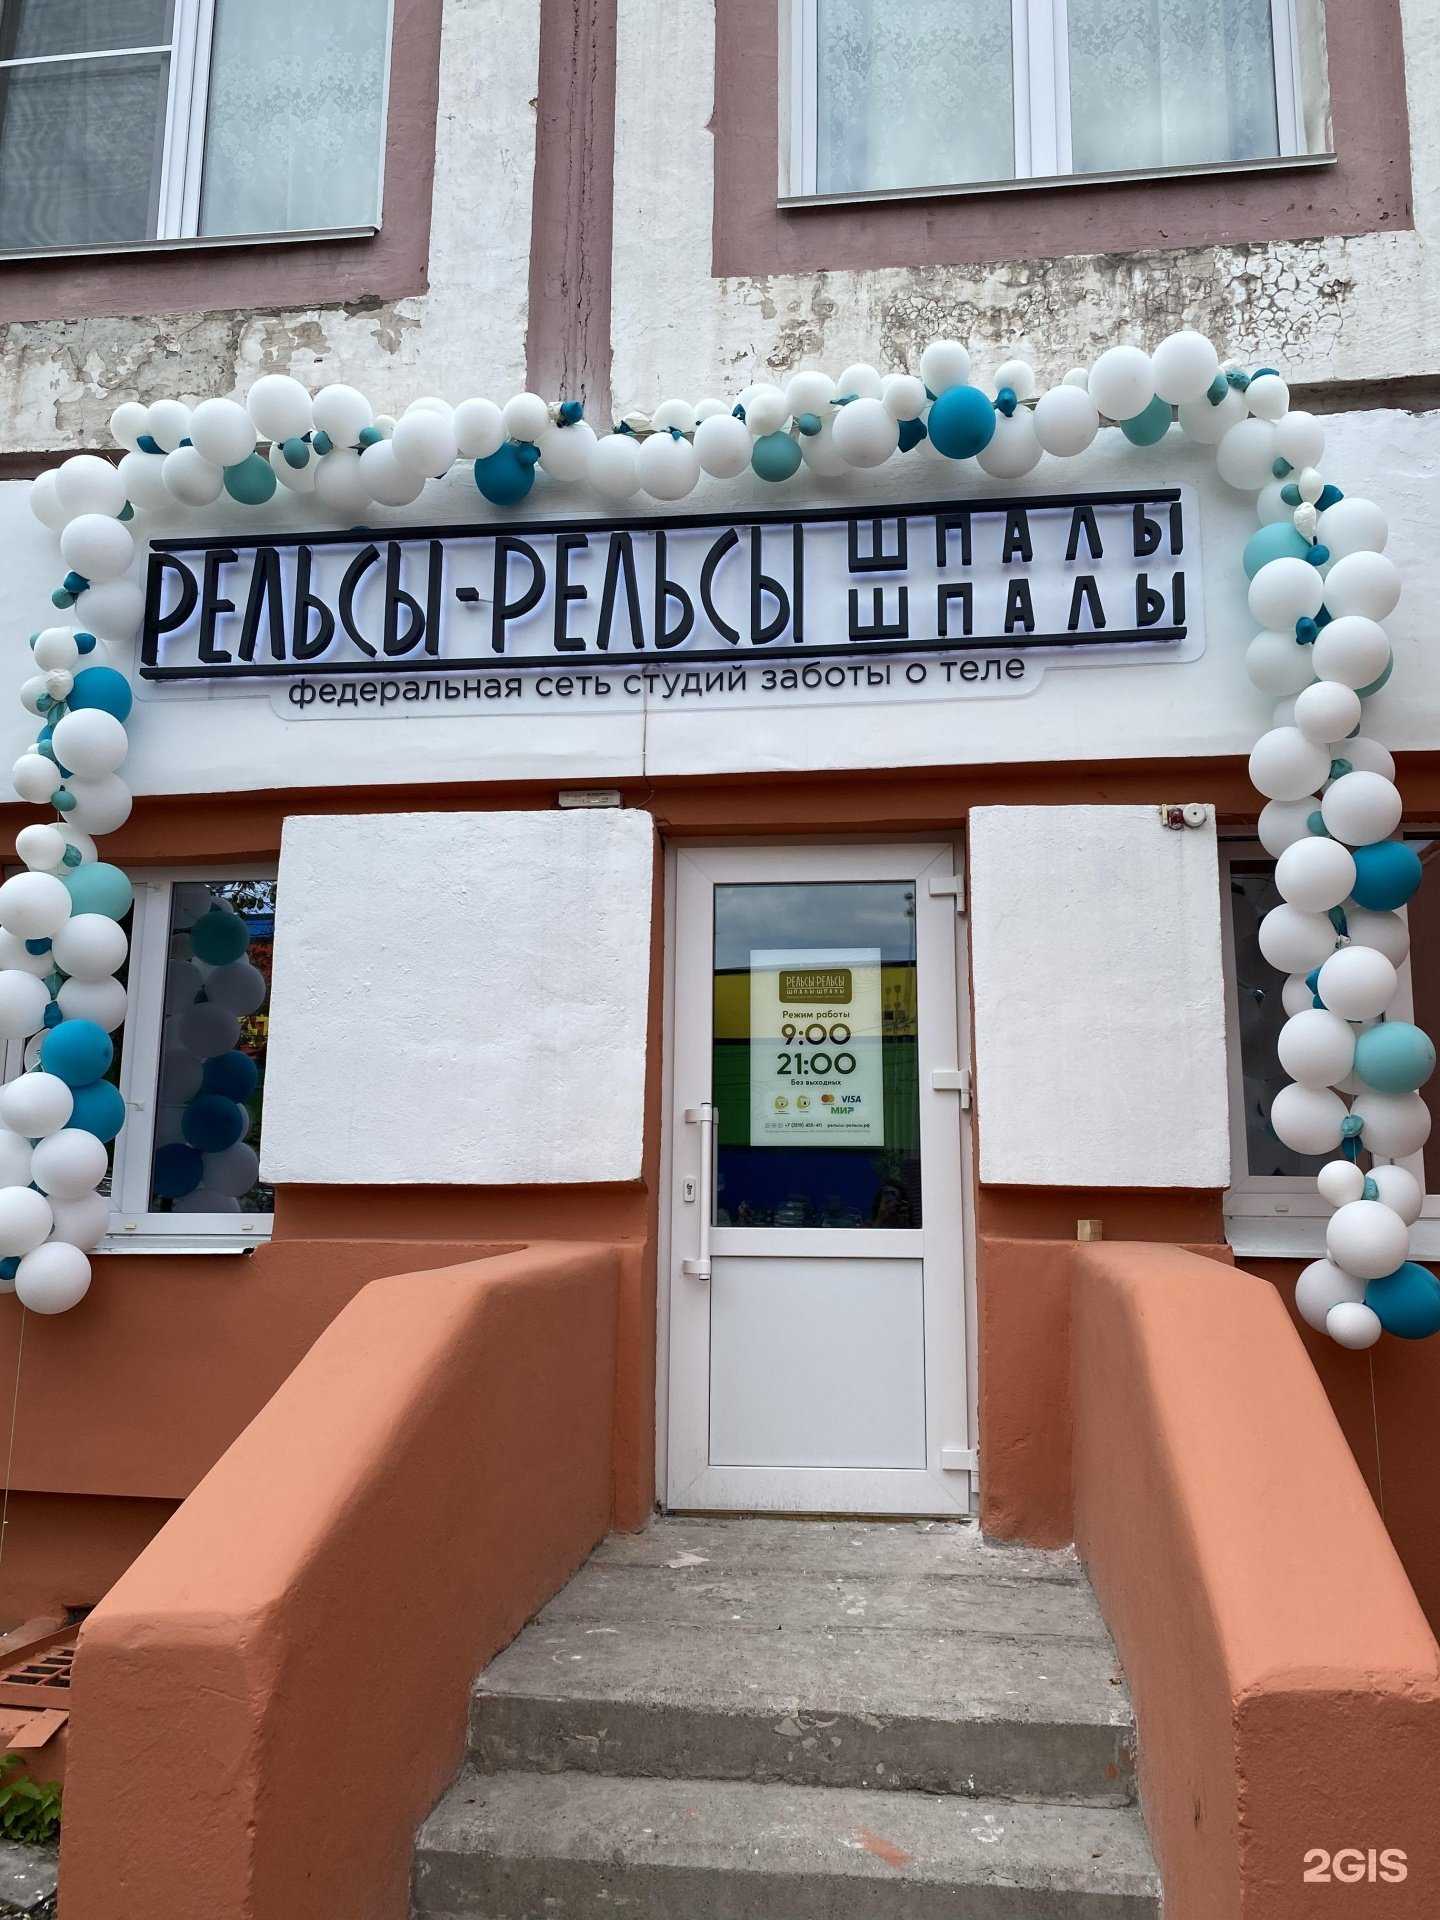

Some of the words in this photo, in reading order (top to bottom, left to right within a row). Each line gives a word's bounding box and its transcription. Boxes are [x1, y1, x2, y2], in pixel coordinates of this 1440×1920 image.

[141, 523, 804, 666] РЕЛЬСЫ-РЕЛЬСЫ
[848, 502, 1183, 572] ШПАЛЫ
[848, 572, 1186, 640] ШПАЛЫ
[288, 675, 522, 707] федеральная
[535, 674, 612, 697] сеть
[623, 664, 747, 699] студий
[760, 660, 891, 690] заботы
[905, 663, 927, 684] о
[939, 655, 1026, 682] теле
[782, 1010, 813, 1019] Режим
[816, 1010, 850, 1020] работы
[781, 1023, 851, 1046] 9:00
[777, 1052, 857, 1075] 21:00
[830, 1106, 854, 1115] МИР
[841, 1095, 862, 1103] VISA
